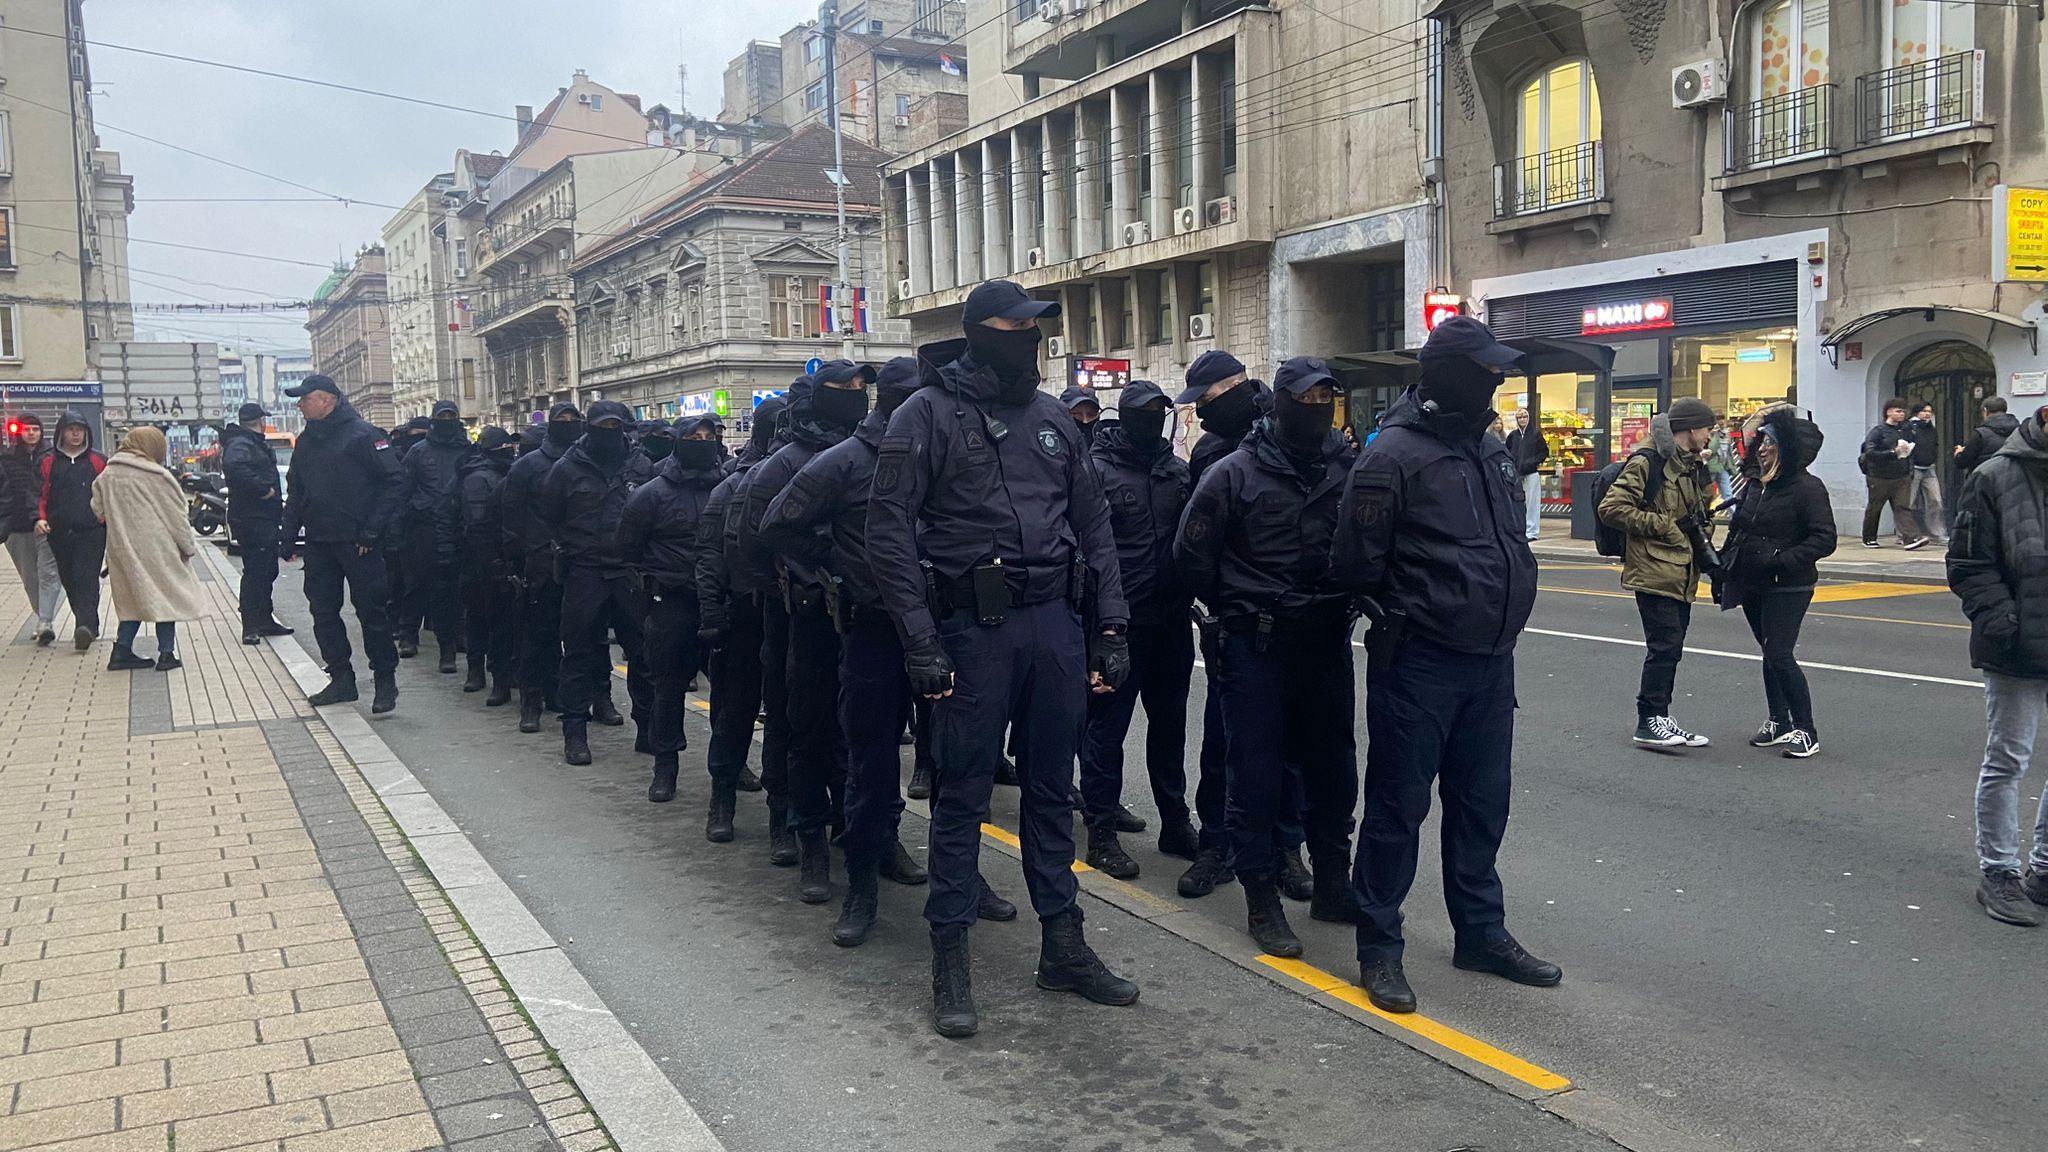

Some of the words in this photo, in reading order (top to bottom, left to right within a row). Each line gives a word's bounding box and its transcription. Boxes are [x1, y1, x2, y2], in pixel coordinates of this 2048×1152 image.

[2020, 199, 2043, 208] COPY
[2018, 232, 2043, 241] CENTAR
[1597, 302, 1643, 326] MAXI
[26, 385, 83, 393] ШТЕДИОНИЦА
